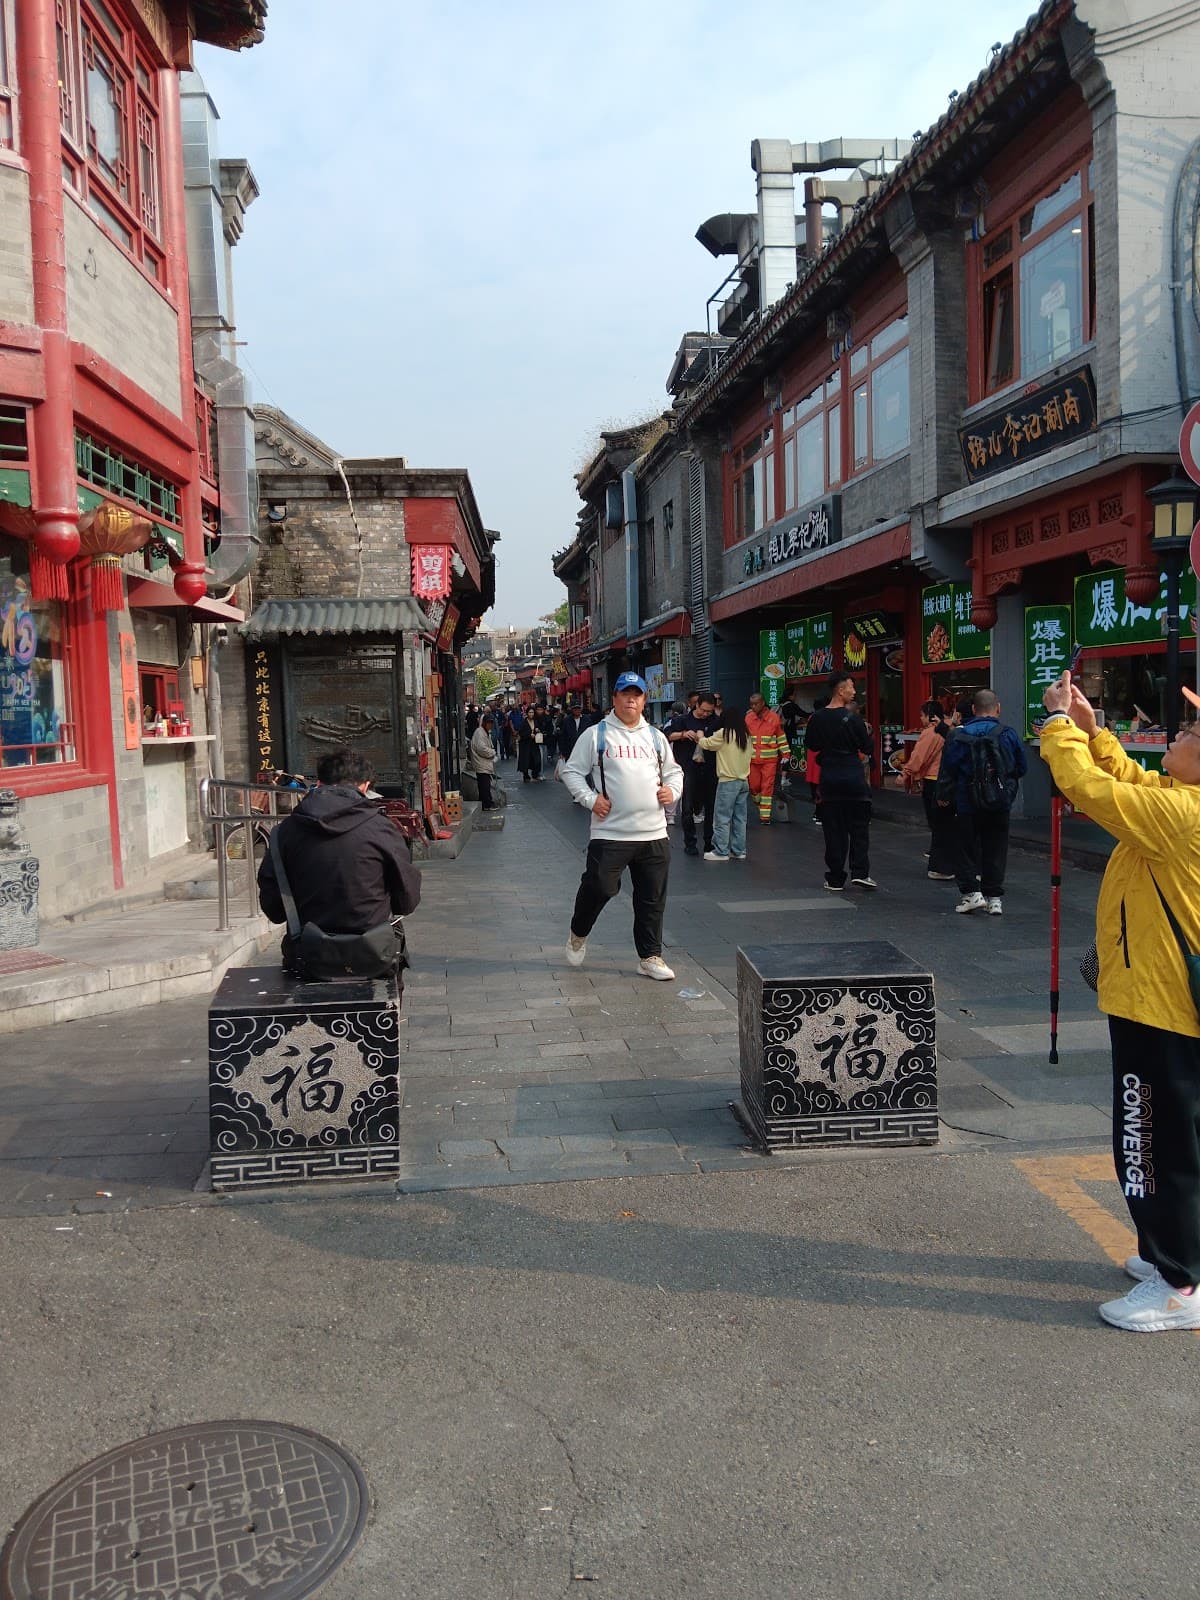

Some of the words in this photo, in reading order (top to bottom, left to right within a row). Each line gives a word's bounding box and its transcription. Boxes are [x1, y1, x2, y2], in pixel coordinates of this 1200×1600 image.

[967, 388, 1080, 470] 鸭儿李记涮肉
[421, 555, 443, 591] 剪纸
[1030, 619, 1066, 685] 爆肚王
[262, 1041, 346, 1119] 福
[814, 1013, 887, 1084] 福
[1122, 1072, 1145, 1199] CONVERGE
